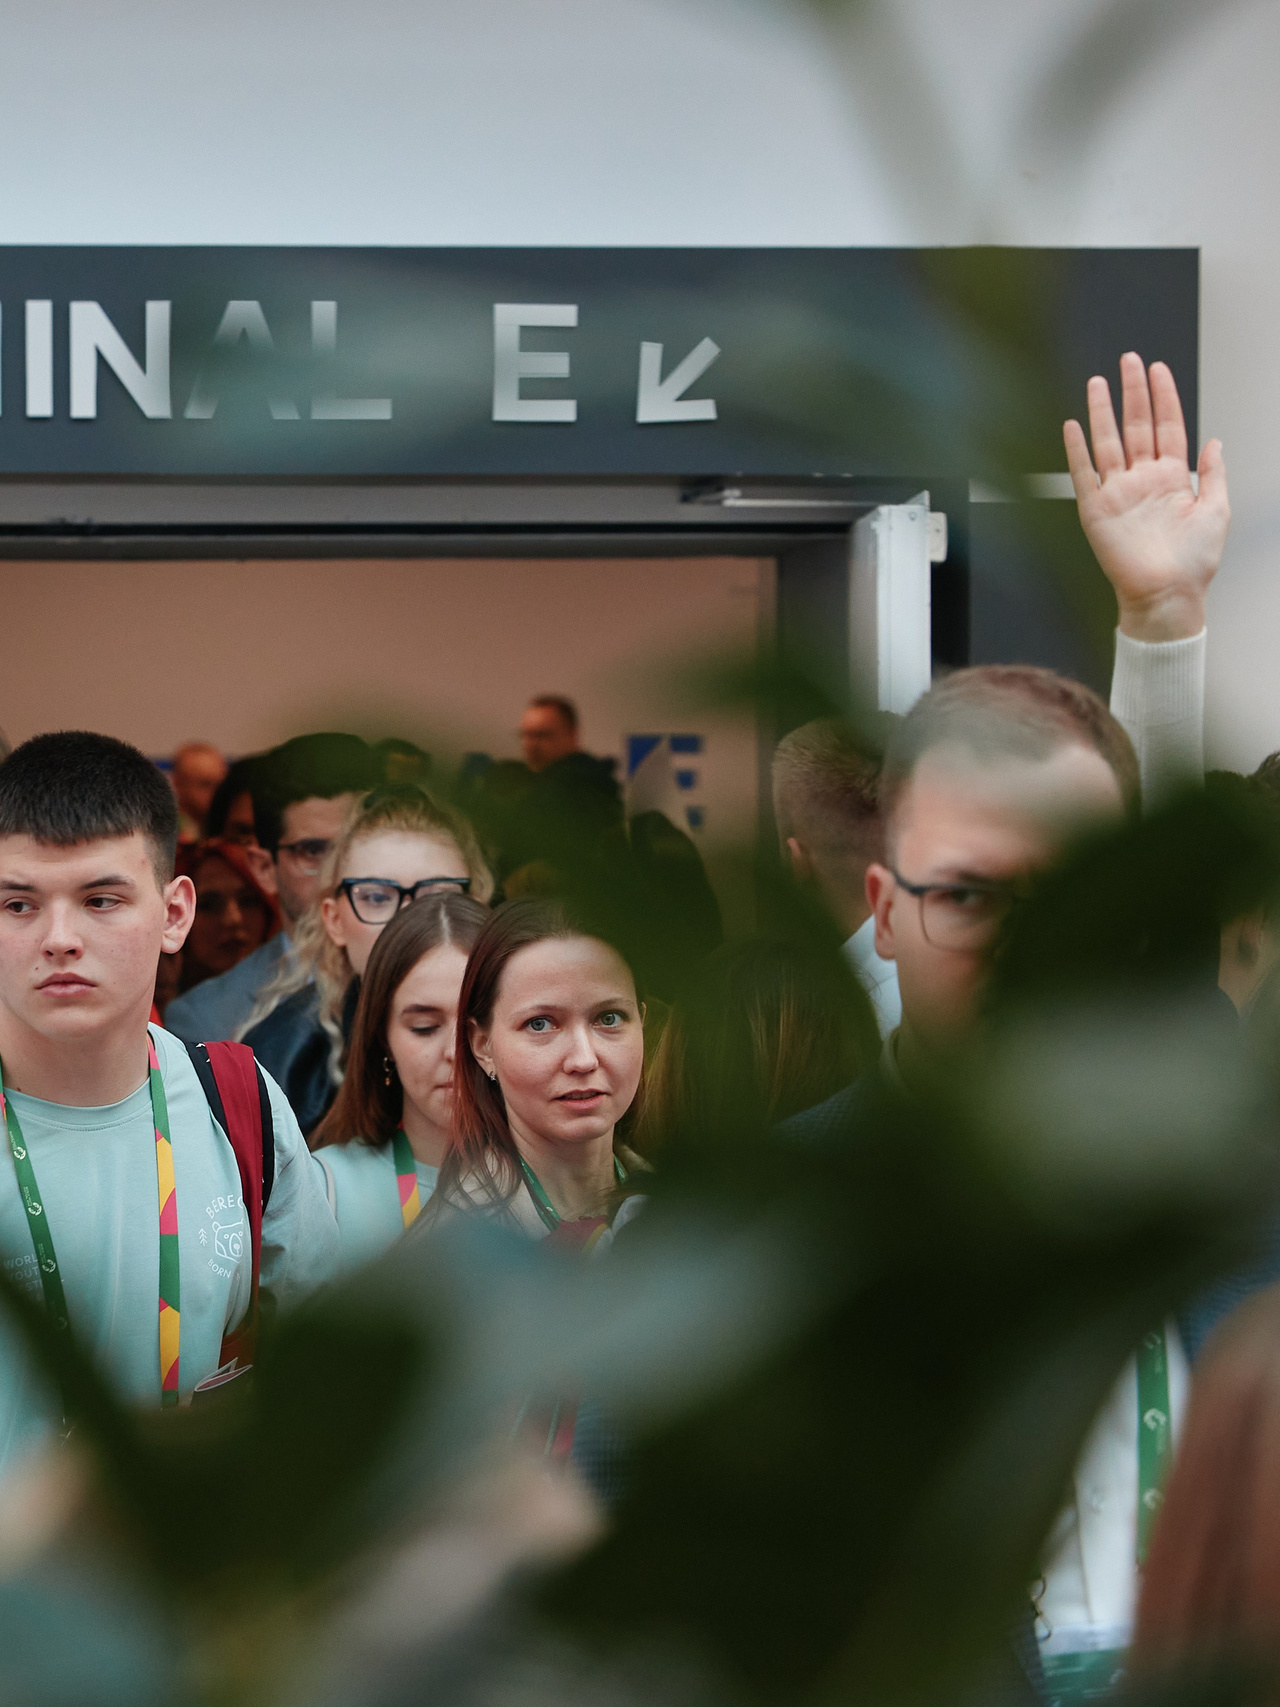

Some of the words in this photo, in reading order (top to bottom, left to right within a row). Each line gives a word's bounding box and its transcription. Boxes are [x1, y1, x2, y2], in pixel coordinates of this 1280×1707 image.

[492, 303, 579, 422] E
[3, 1253, 39, 1270] WORL
[207, 1258, 232, 1279] BORN
